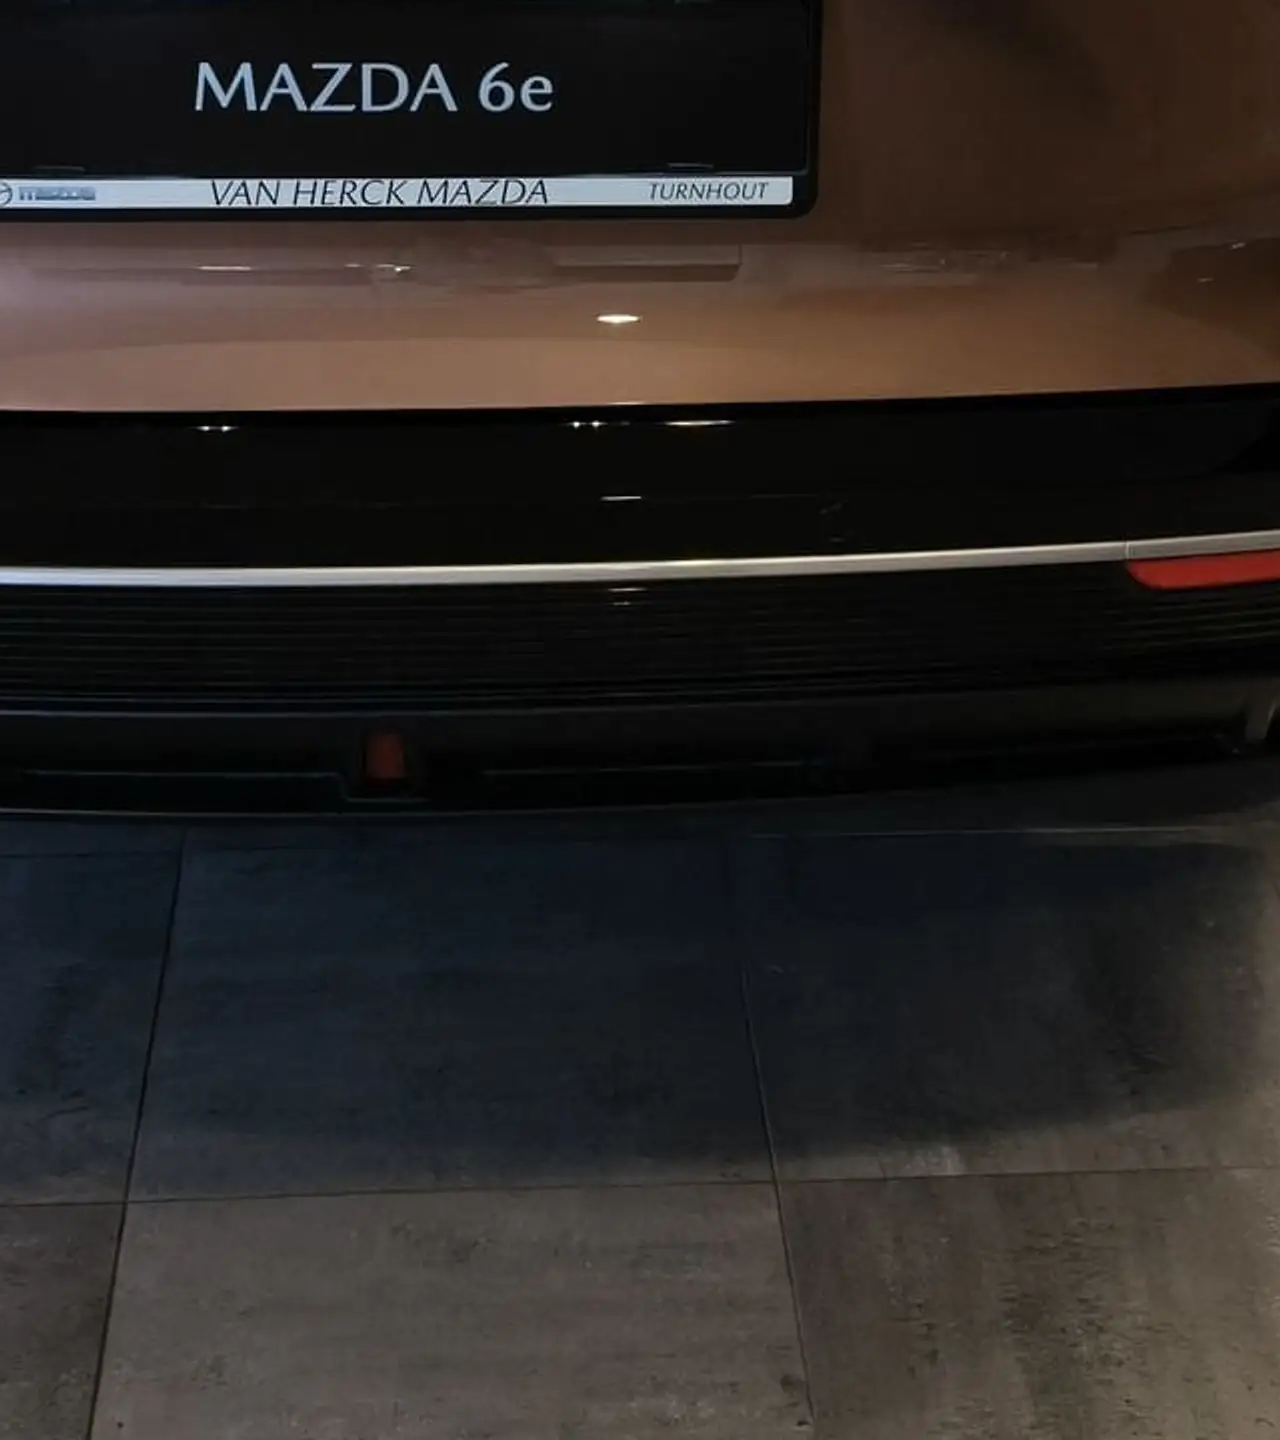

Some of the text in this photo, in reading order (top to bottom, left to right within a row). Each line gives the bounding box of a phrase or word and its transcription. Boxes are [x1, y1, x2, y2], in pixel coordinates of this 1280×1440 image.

[194, 61, 554, 112] MAZDA 6e
[210, 178, 549, 207] VAN HERCK MAZDA
[649, 181, 769, 201] TURNHOUT
